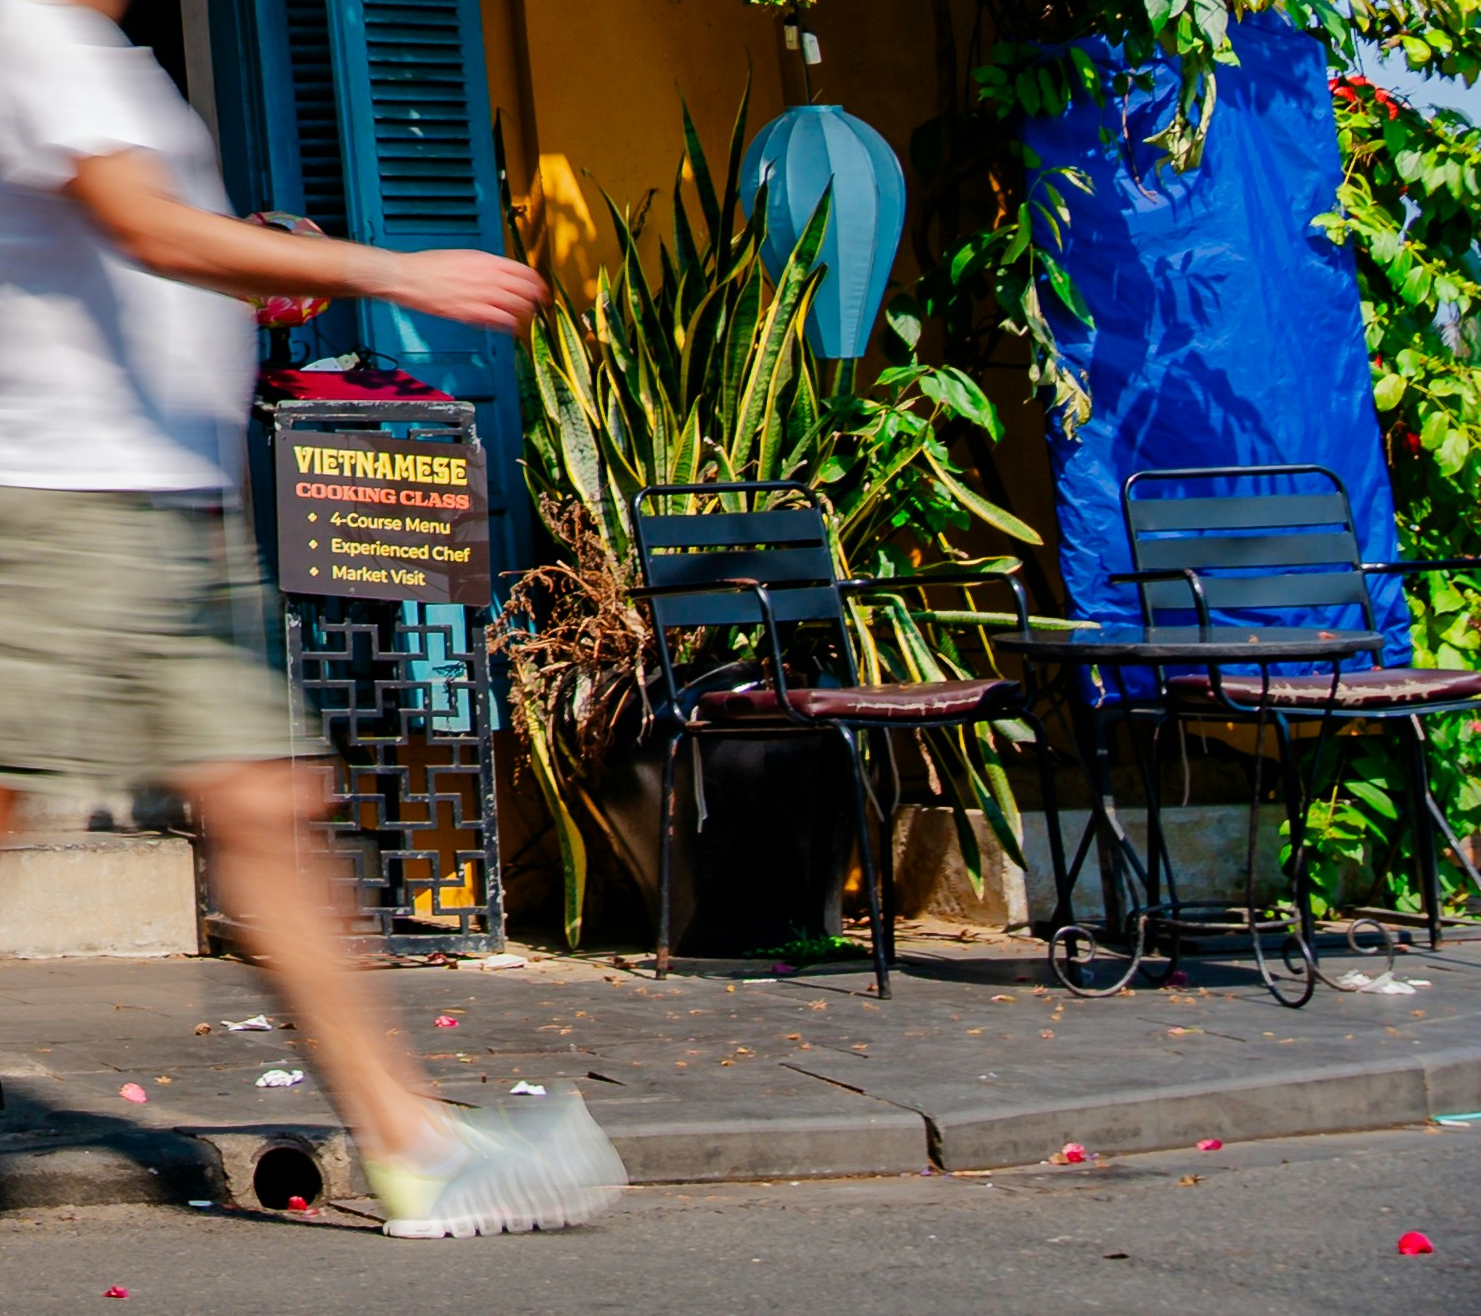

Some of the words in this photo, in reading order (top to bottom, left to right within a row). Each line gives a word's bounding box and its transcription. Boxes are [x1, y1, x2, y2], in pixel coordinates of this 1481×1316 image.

[294, 445, 468, 486] VIETNAMESE
[295, 482, 397, 504] COOKING
[399, 490, 470, 510] CLASS
[330, 511, 402, 531] 4-Course
[406, 518, 451, 535] Menu
[331, 538, 429, 559] Experienced
[432, 546, 471, 563] Chef
[332, 565, 388, 584] Market
[391, 569, 426, 586] Visit
